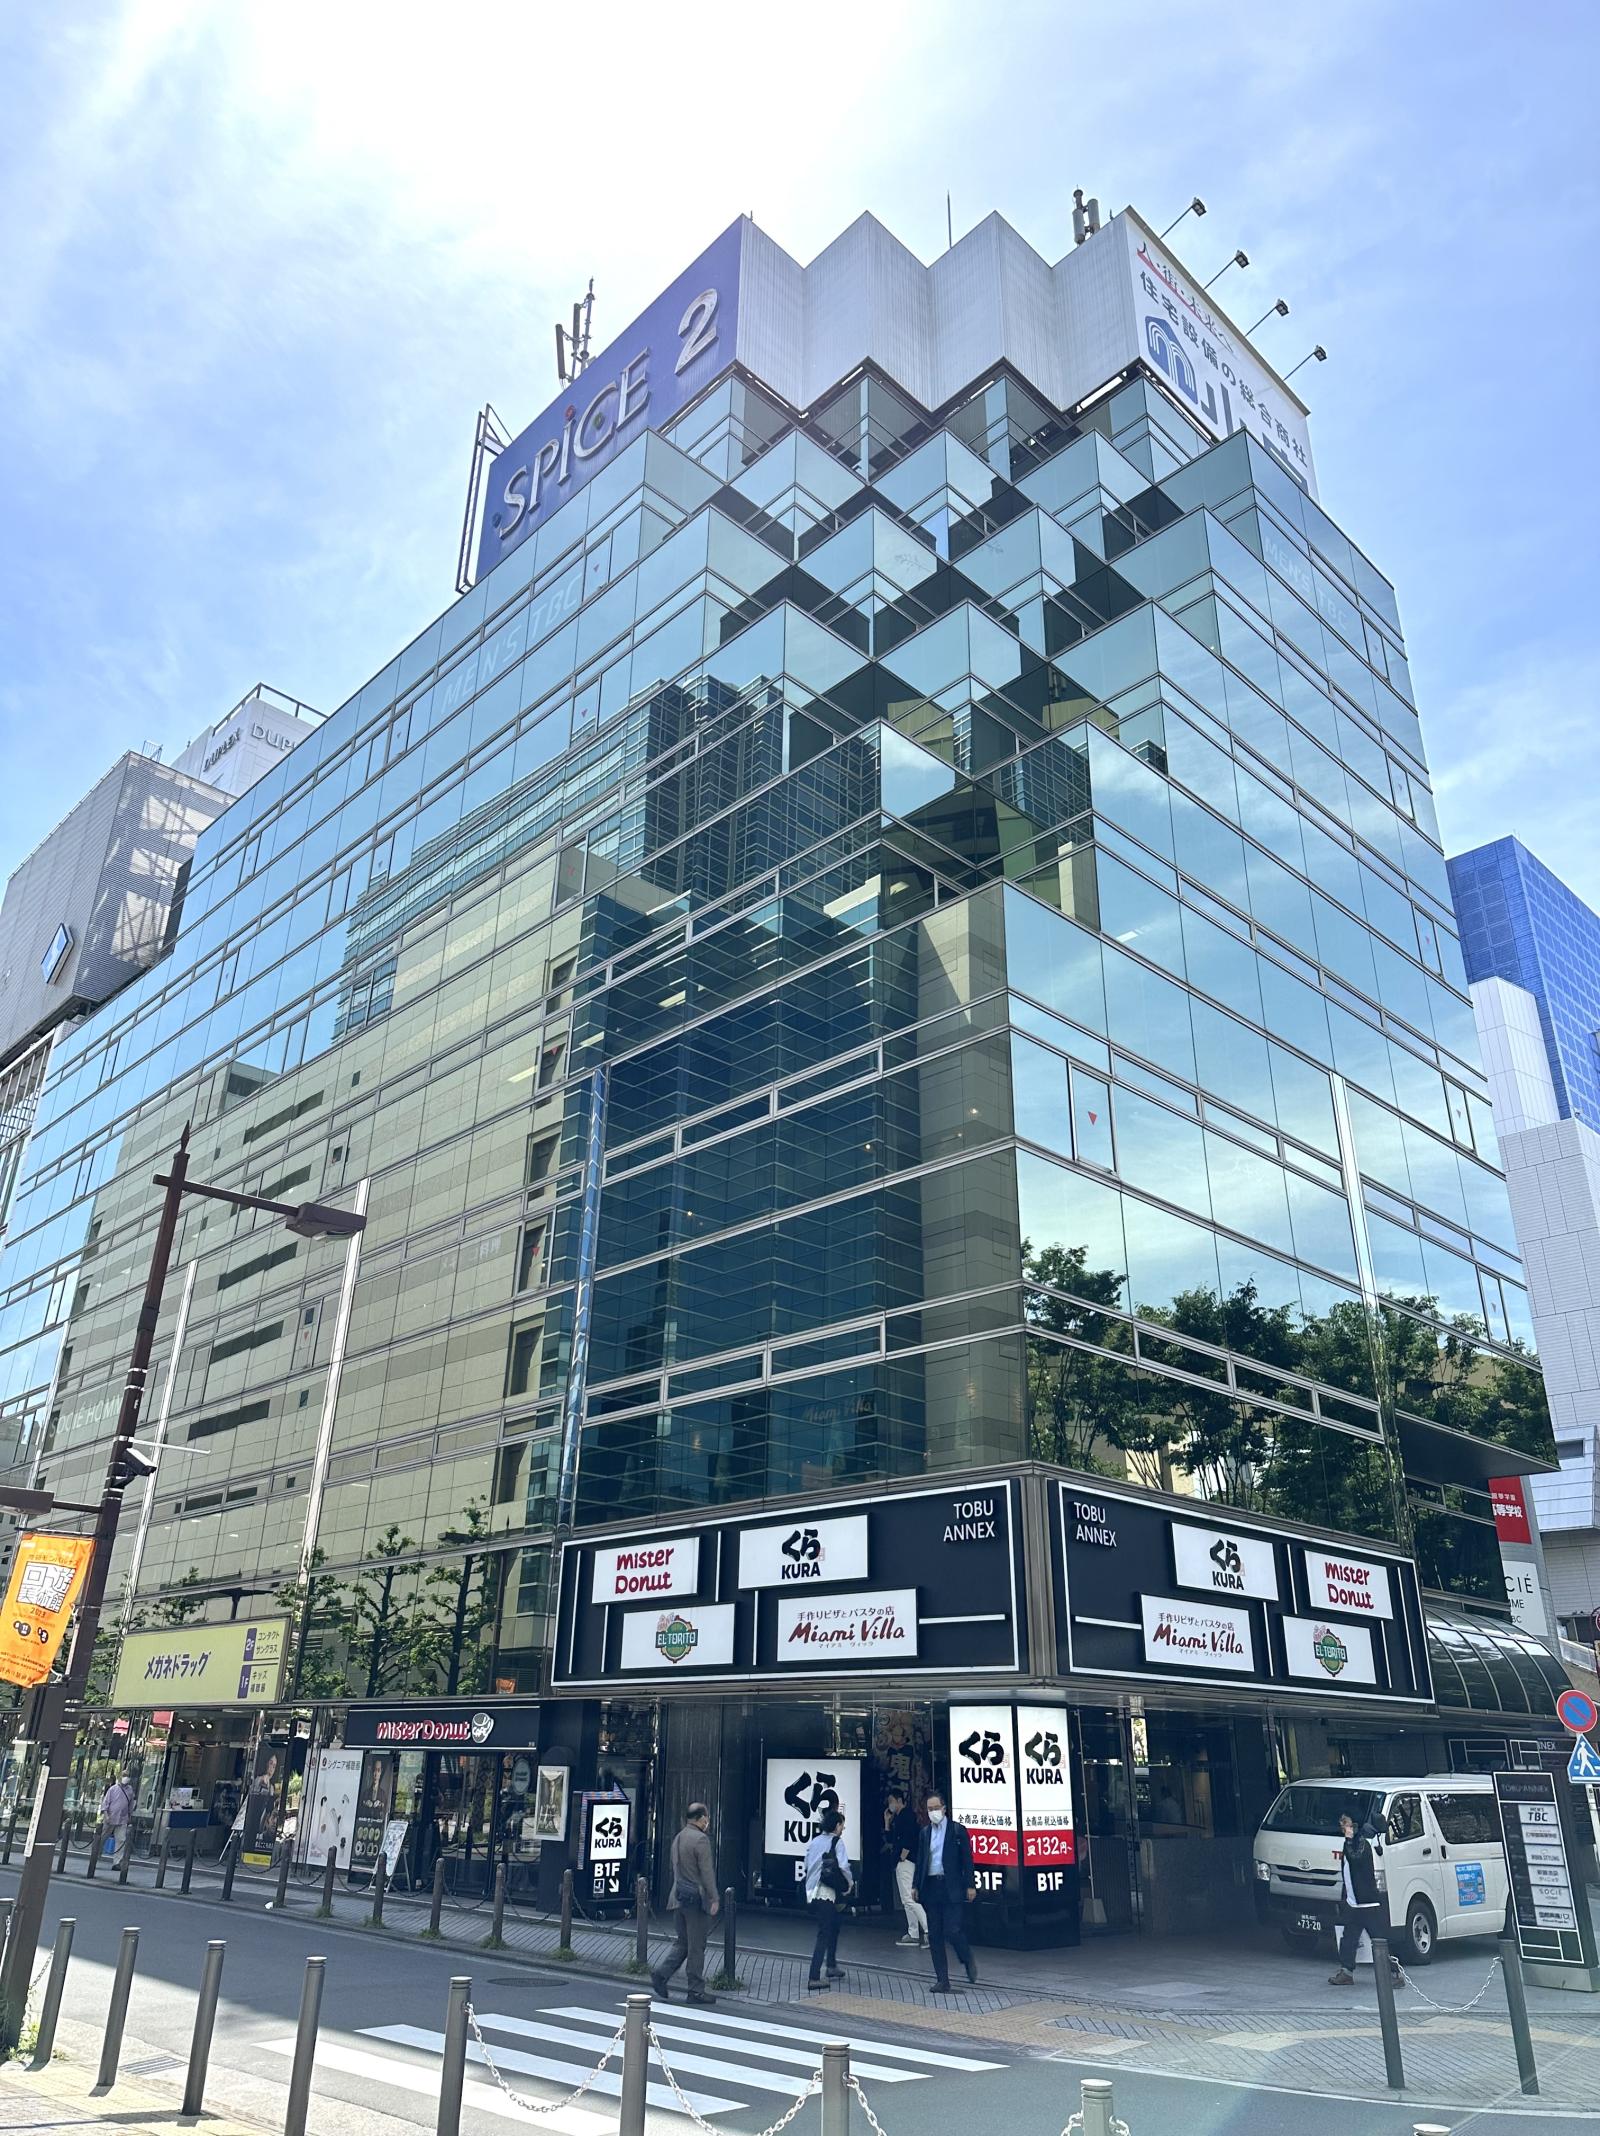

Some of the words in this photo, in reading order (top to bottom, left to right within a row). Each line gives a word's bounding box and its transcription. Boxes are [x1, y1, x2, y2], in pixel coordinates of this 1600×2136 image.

[673, 288, 720, 377] 2
[1140, 271, 1308, 468] 住宅設備の総合商社
[1263, 536, 1311, 594] MEN'S
[1317, 590, 1348, 632] TBC
[441, 626, 522, 714] MEN'S
[531, 572, 583, 640] TBC
[250, 721, 297, 752] DUP
[953, 1499, 994, 1520] TOBU
[1073, 1501, 1106, 1524] TOBU
[943, 1521, 995, 1543] ANNEX
[1076, 1524, 1117, 1547] ANNEX
[781, 1528, 821, 1562] くら
[1209, 1538, 1242, 1573] くら
[781, 1562, 821, 1580] KURA
[1212, 1571, 1245, 1591] KURA
[615, 1571, 673, 1594] Donut
[1504, 1573, 1534, 1594] CIÉ
[1327, 1583, 1374, 1609] Donut
[1511, 1599, 1525, 1609] ME
[797, 1605, 895, 1621] 手作りピザとパスタの店
[1158, 1612, 1235, 1632] 手作りピザとパスタの店
[257, 1630, 280, 1641] コンタクト
[788, 1622, 855, 1643] Miami
[861, 1616, 905, 1641] Villa
[1153, 1623, 1208, 1650] Miami
[1211, 1630, 1244, 1654] Villa
[245, 1638, 255, 1651] 2F
[255, 1644, 278, 1655] サングラス
[144, 1651, 212, 1680] メガネドラッグ
[252, 1669, 268, 1680] キッズ
[240, 1675, 250, 1689] 1F
[421, 1719, 471, 1740] Donut
[958, 1730, 1004, 1766] くら
[1024, 1731, 1062, 1767] くら
[960, 1767, 1006, 1784] KURA
[1026, 1768, 1064, 1785] KURA
[784, 1771, 840, 1819] くら
[595, 1817, 623, 1838] くら
[958, 1814, 979, 1825] 全商品
[980, 1815, 1012, 1827] 税込価格
[1026, 1816, 1043, 1827] 全商品
[1044, 1815, 1070, 1827] 税込価格
[1528, 1812, 1549, 1822] TBC
[784, 1820, 822, 1843] KUR
[594, 1839, 622, 1849] KURA
[594, 1862, 621, 1877] B1F
[1037, 1872, 1064, 1892] B1F
